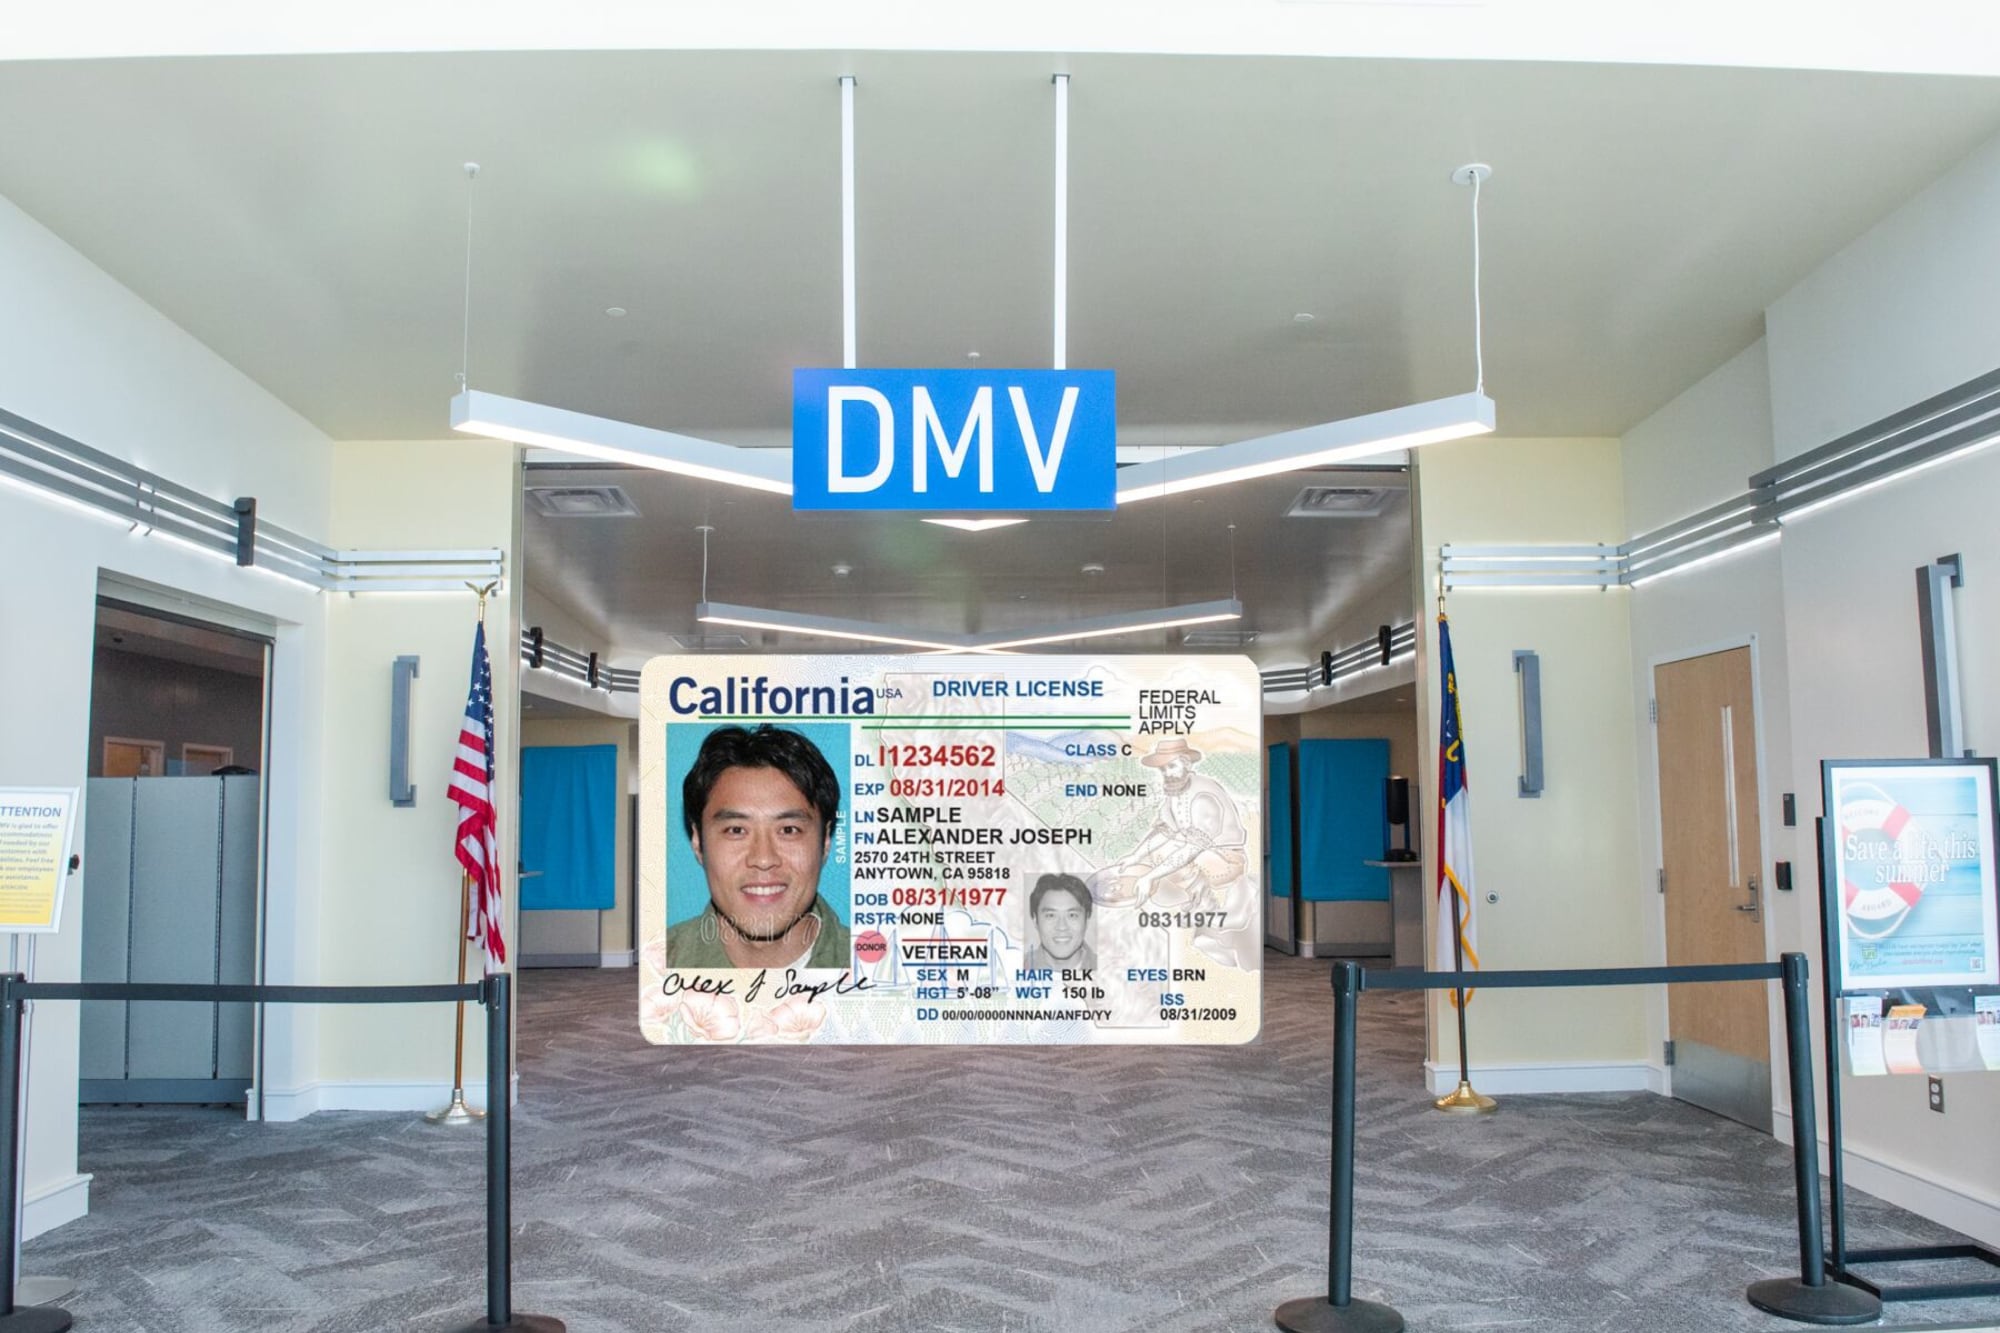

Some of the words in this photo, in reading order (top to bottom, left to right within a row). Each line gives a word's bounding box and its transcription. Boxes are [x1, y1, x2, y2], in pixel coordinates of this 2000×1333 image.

[828, 386, 1080, 493] DMV
[0, 806, 62, 817] TTENTION
[1845, 834, 1887, 861] Save
[1893, 840, 1902, 860] a
[1945, 831, 1976, 859] this
[1875, 862, 1950, 884] summer
